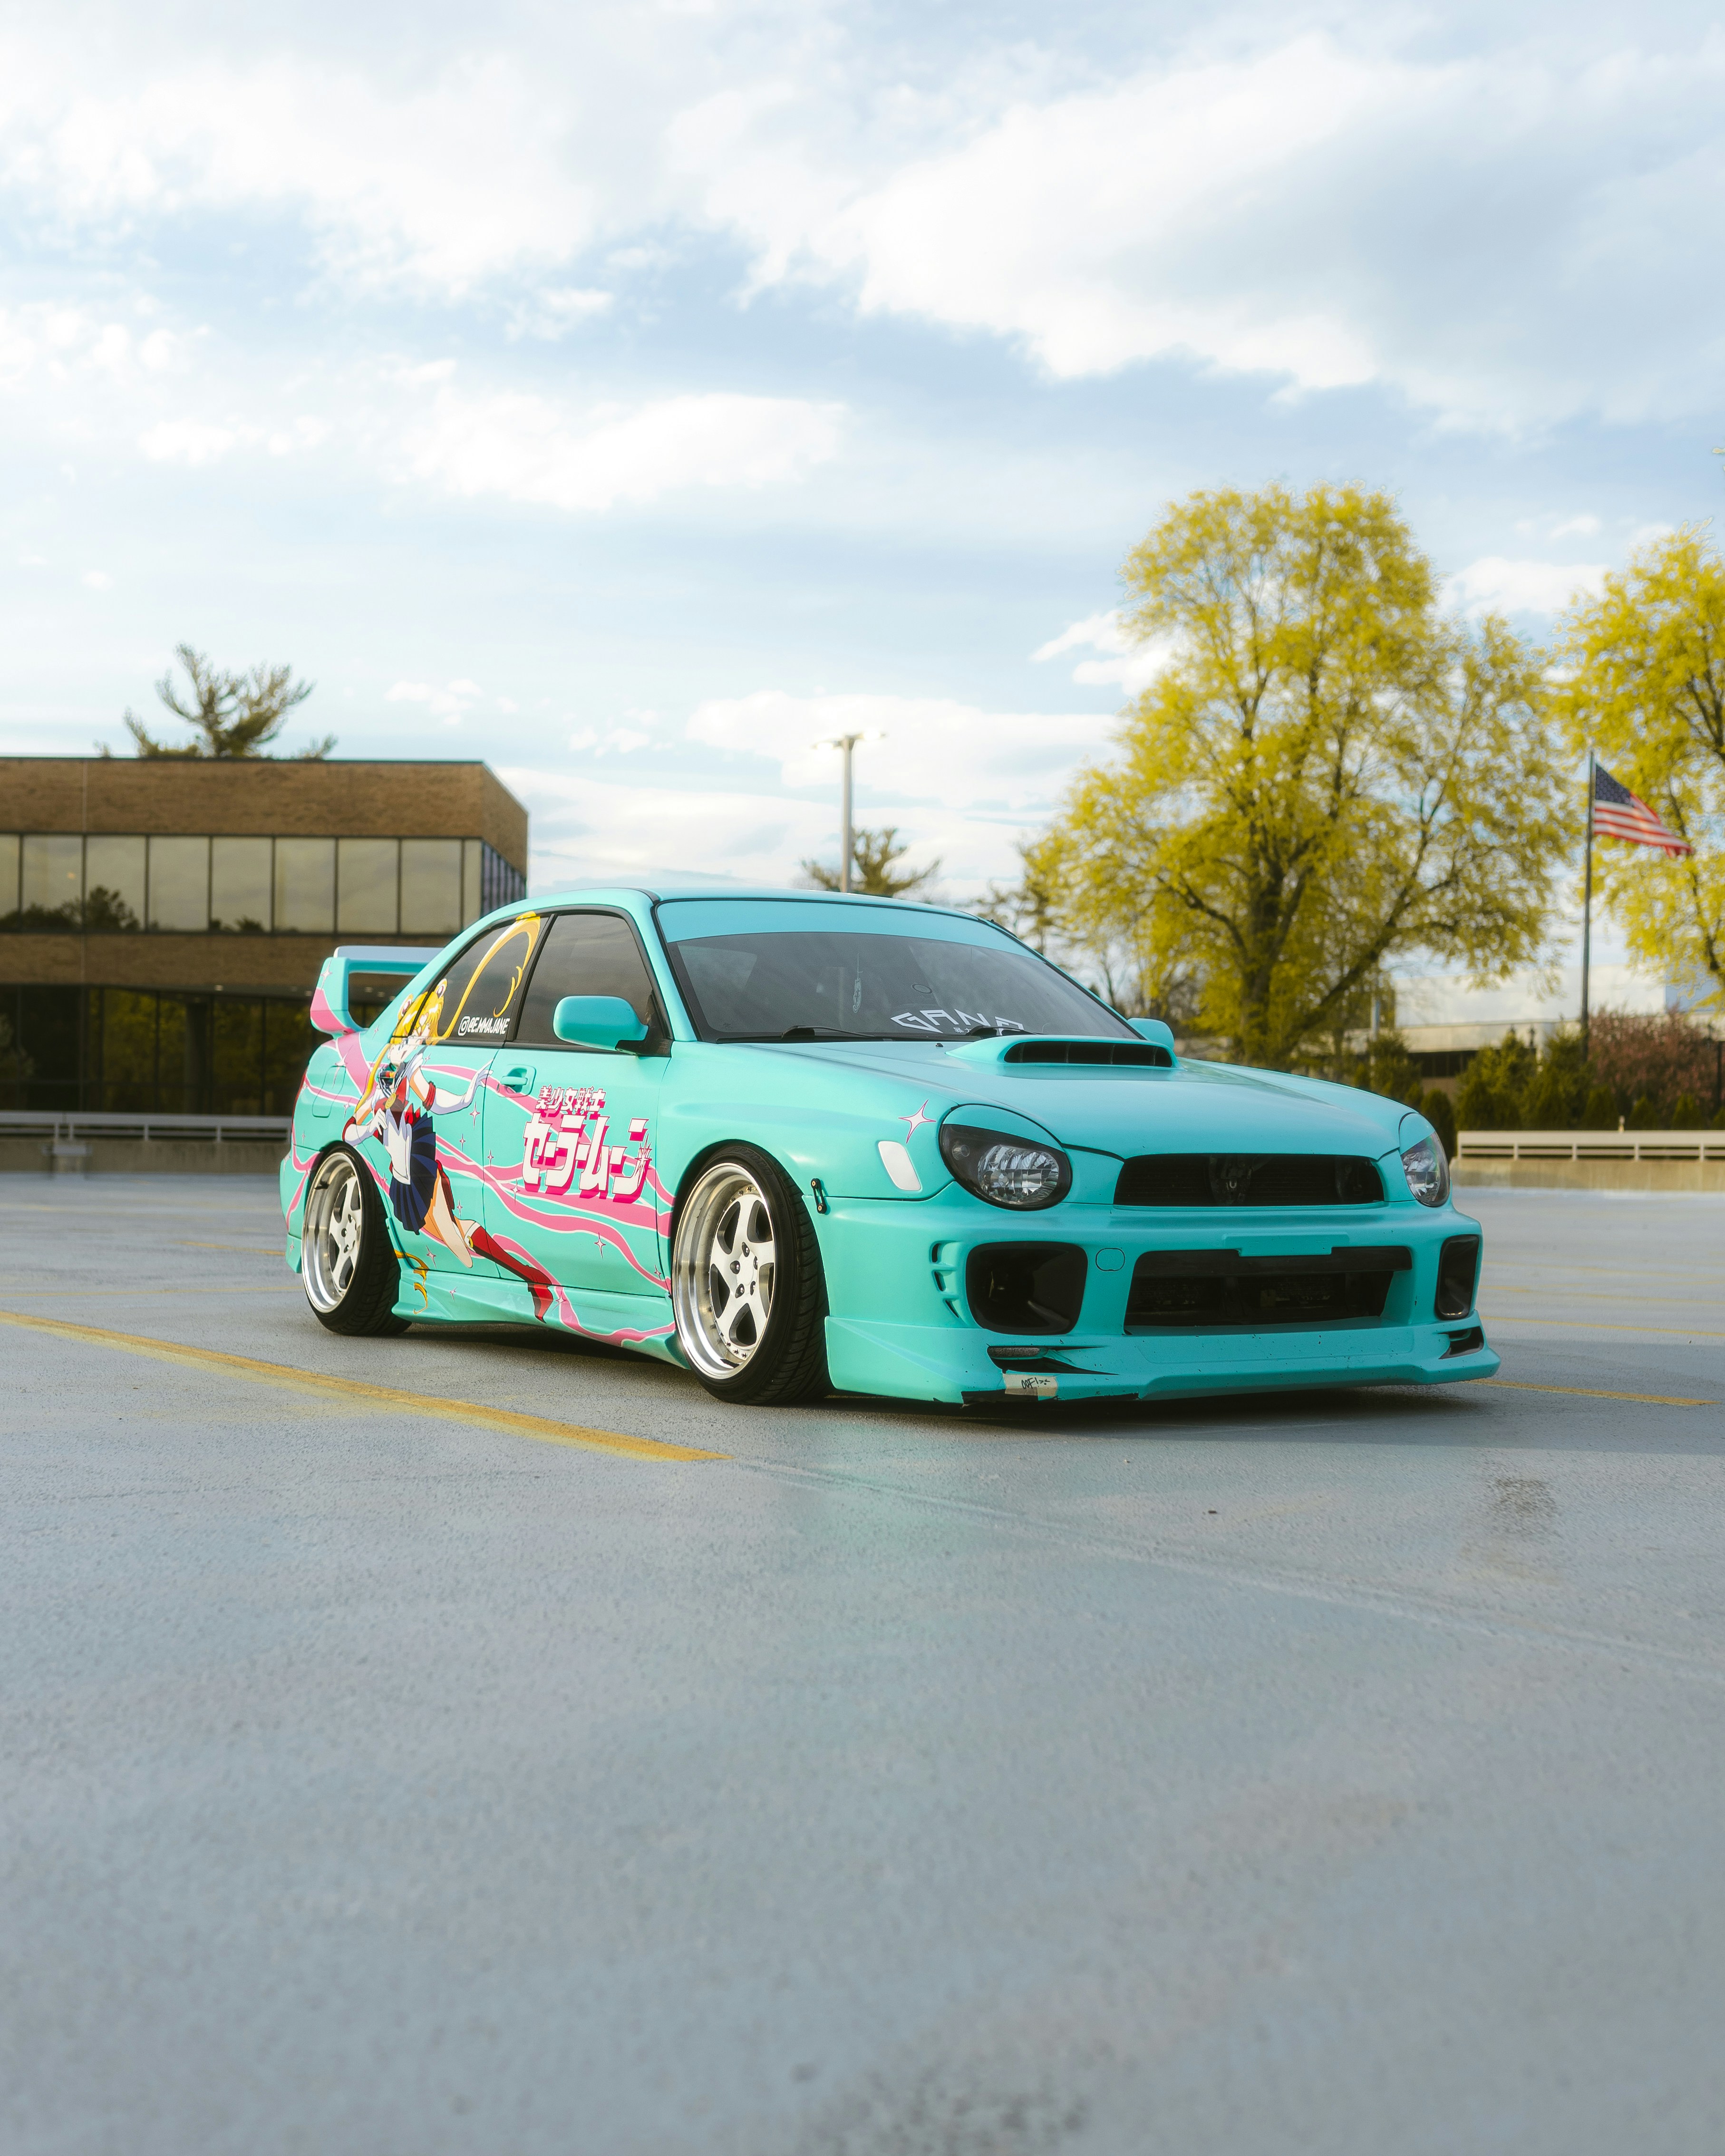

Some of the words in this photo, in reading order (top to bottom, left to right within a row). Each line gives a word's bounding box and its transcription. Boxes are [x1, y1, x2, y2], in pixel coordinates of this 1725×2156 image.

[535, 1085, 606, 1112] 美少女戦士
[522, 1112, 652, 1197] セーラームーン
